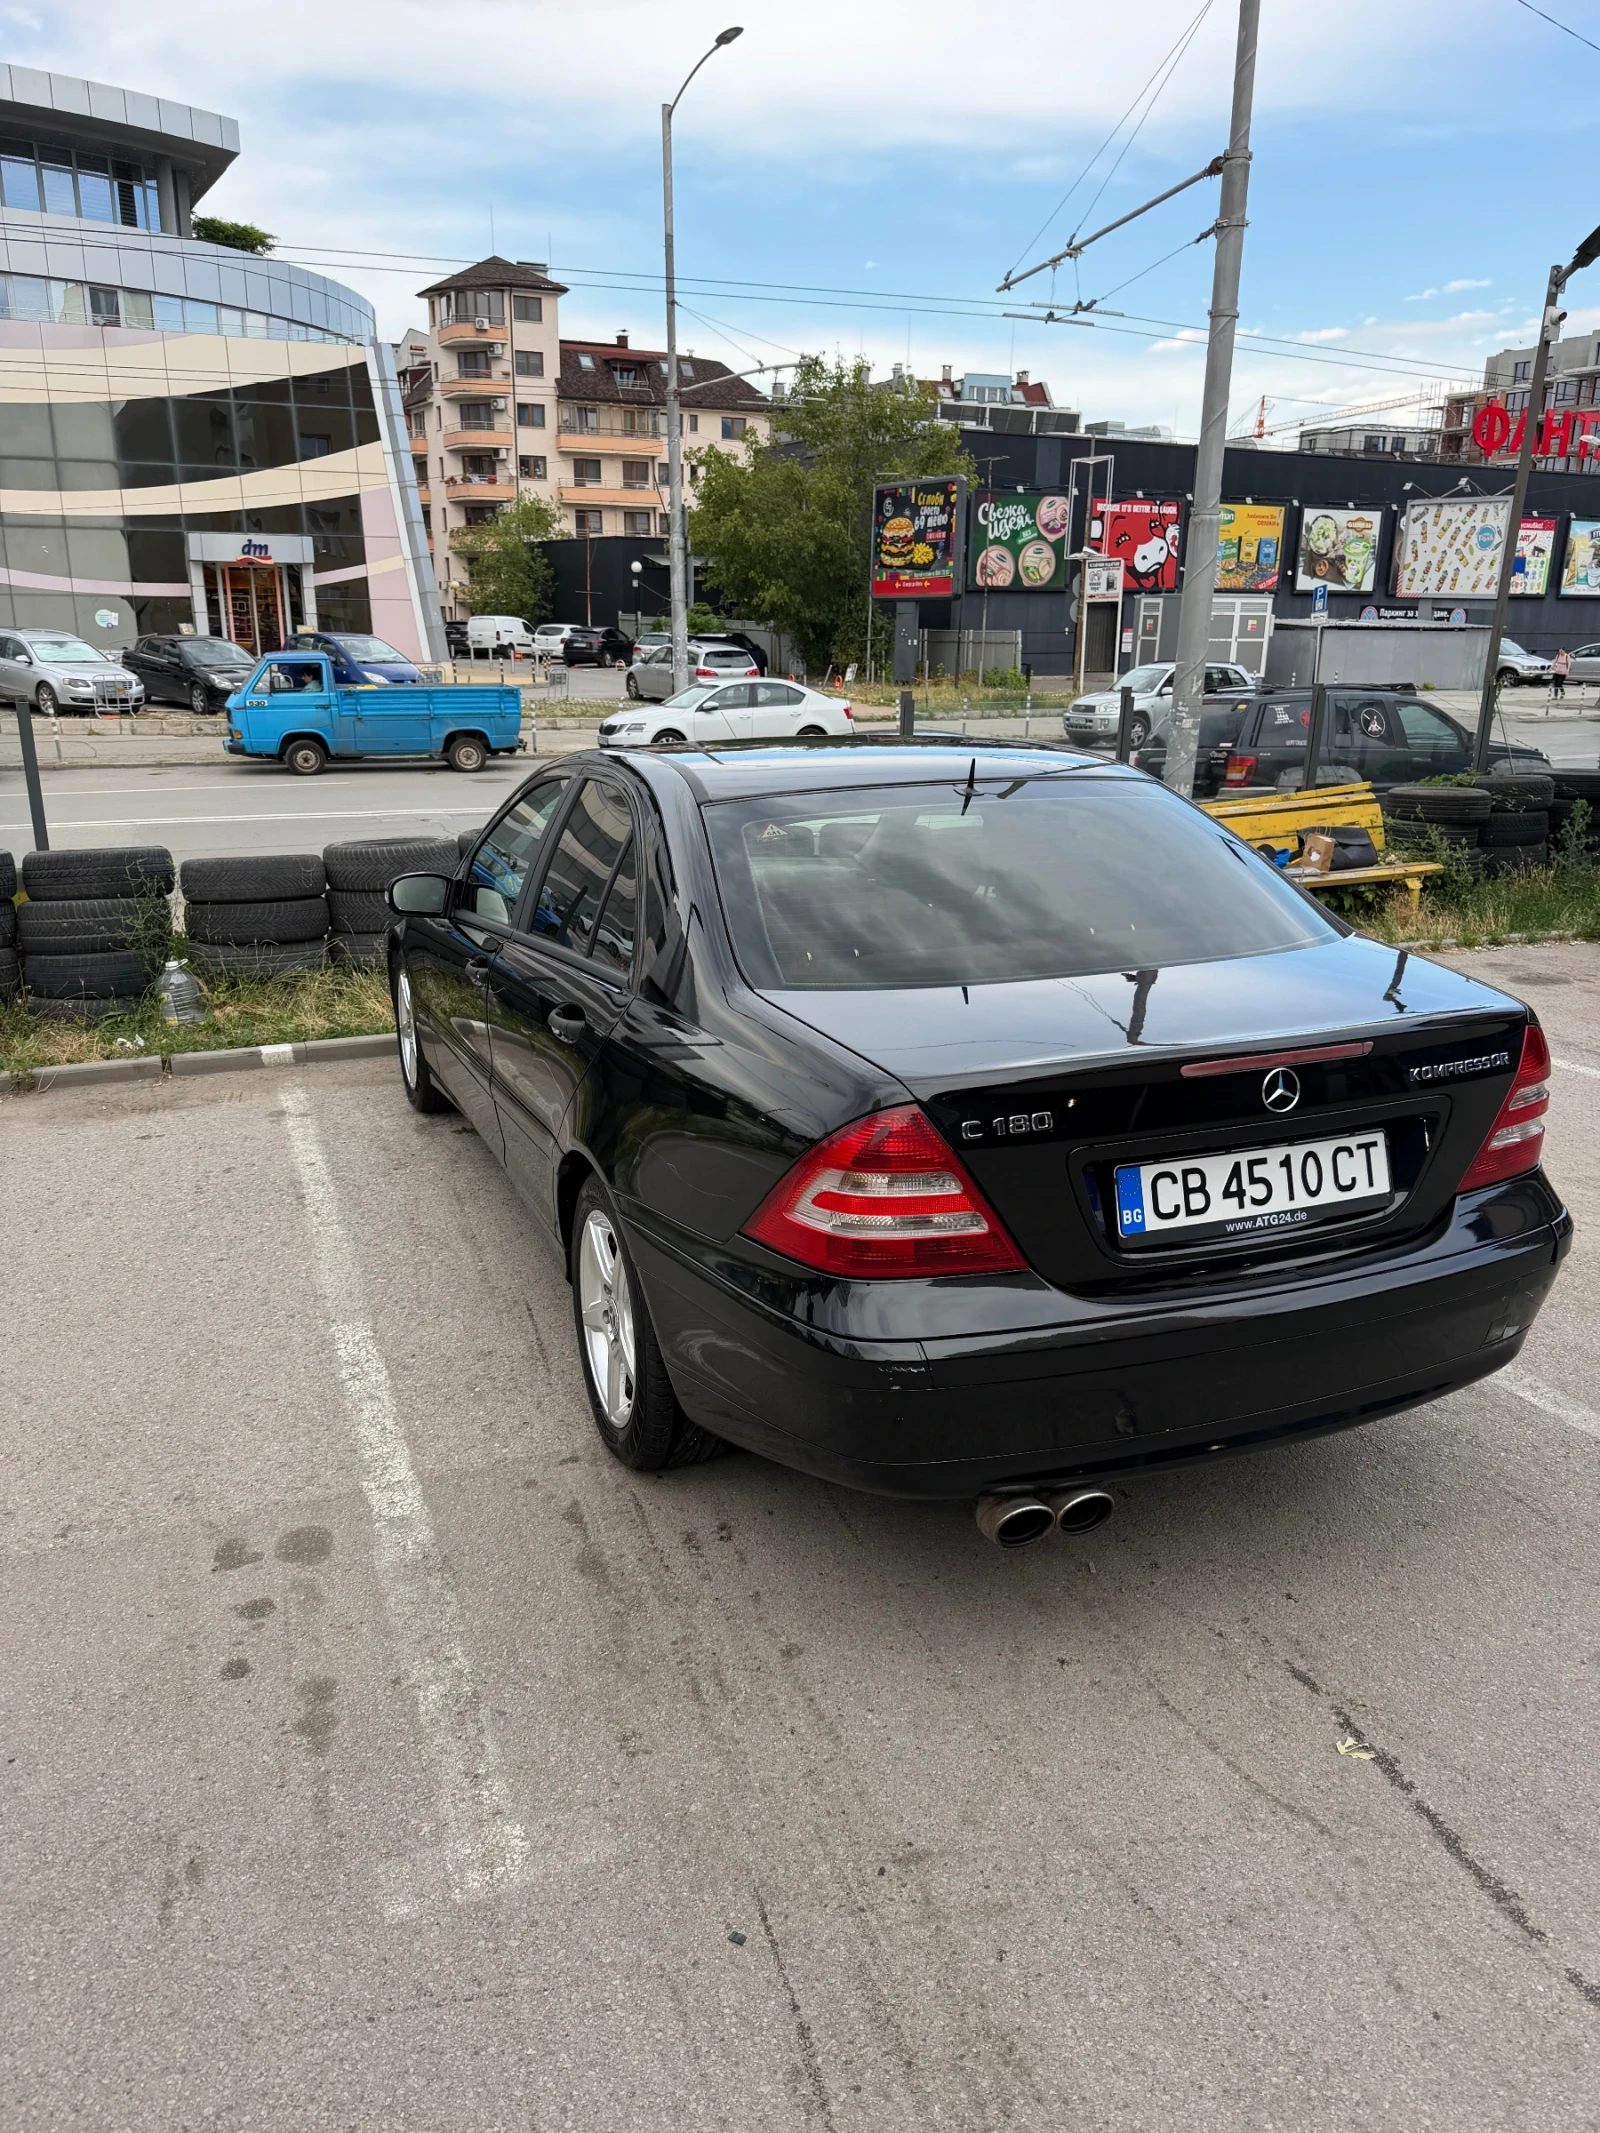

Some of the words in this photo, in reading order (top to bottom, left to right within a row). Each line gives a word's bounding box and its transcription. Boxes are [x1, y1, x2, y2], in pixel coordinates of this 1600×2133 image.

[1473, 400, 1600, 461] ФАНТ
[241, 539, 269, 555] dm
[1380, 608, 1406, 618] Паркинг
[1409, 1052, 1510, 1081] KOMPRESSOR
[962, 1120, 983, 1140] C
[993, 1111, 1053, 1136] 180
[1122, 1209, 1143, 1225] BG
[1226, 1210, 1307, 1232] www.ATG24.de
